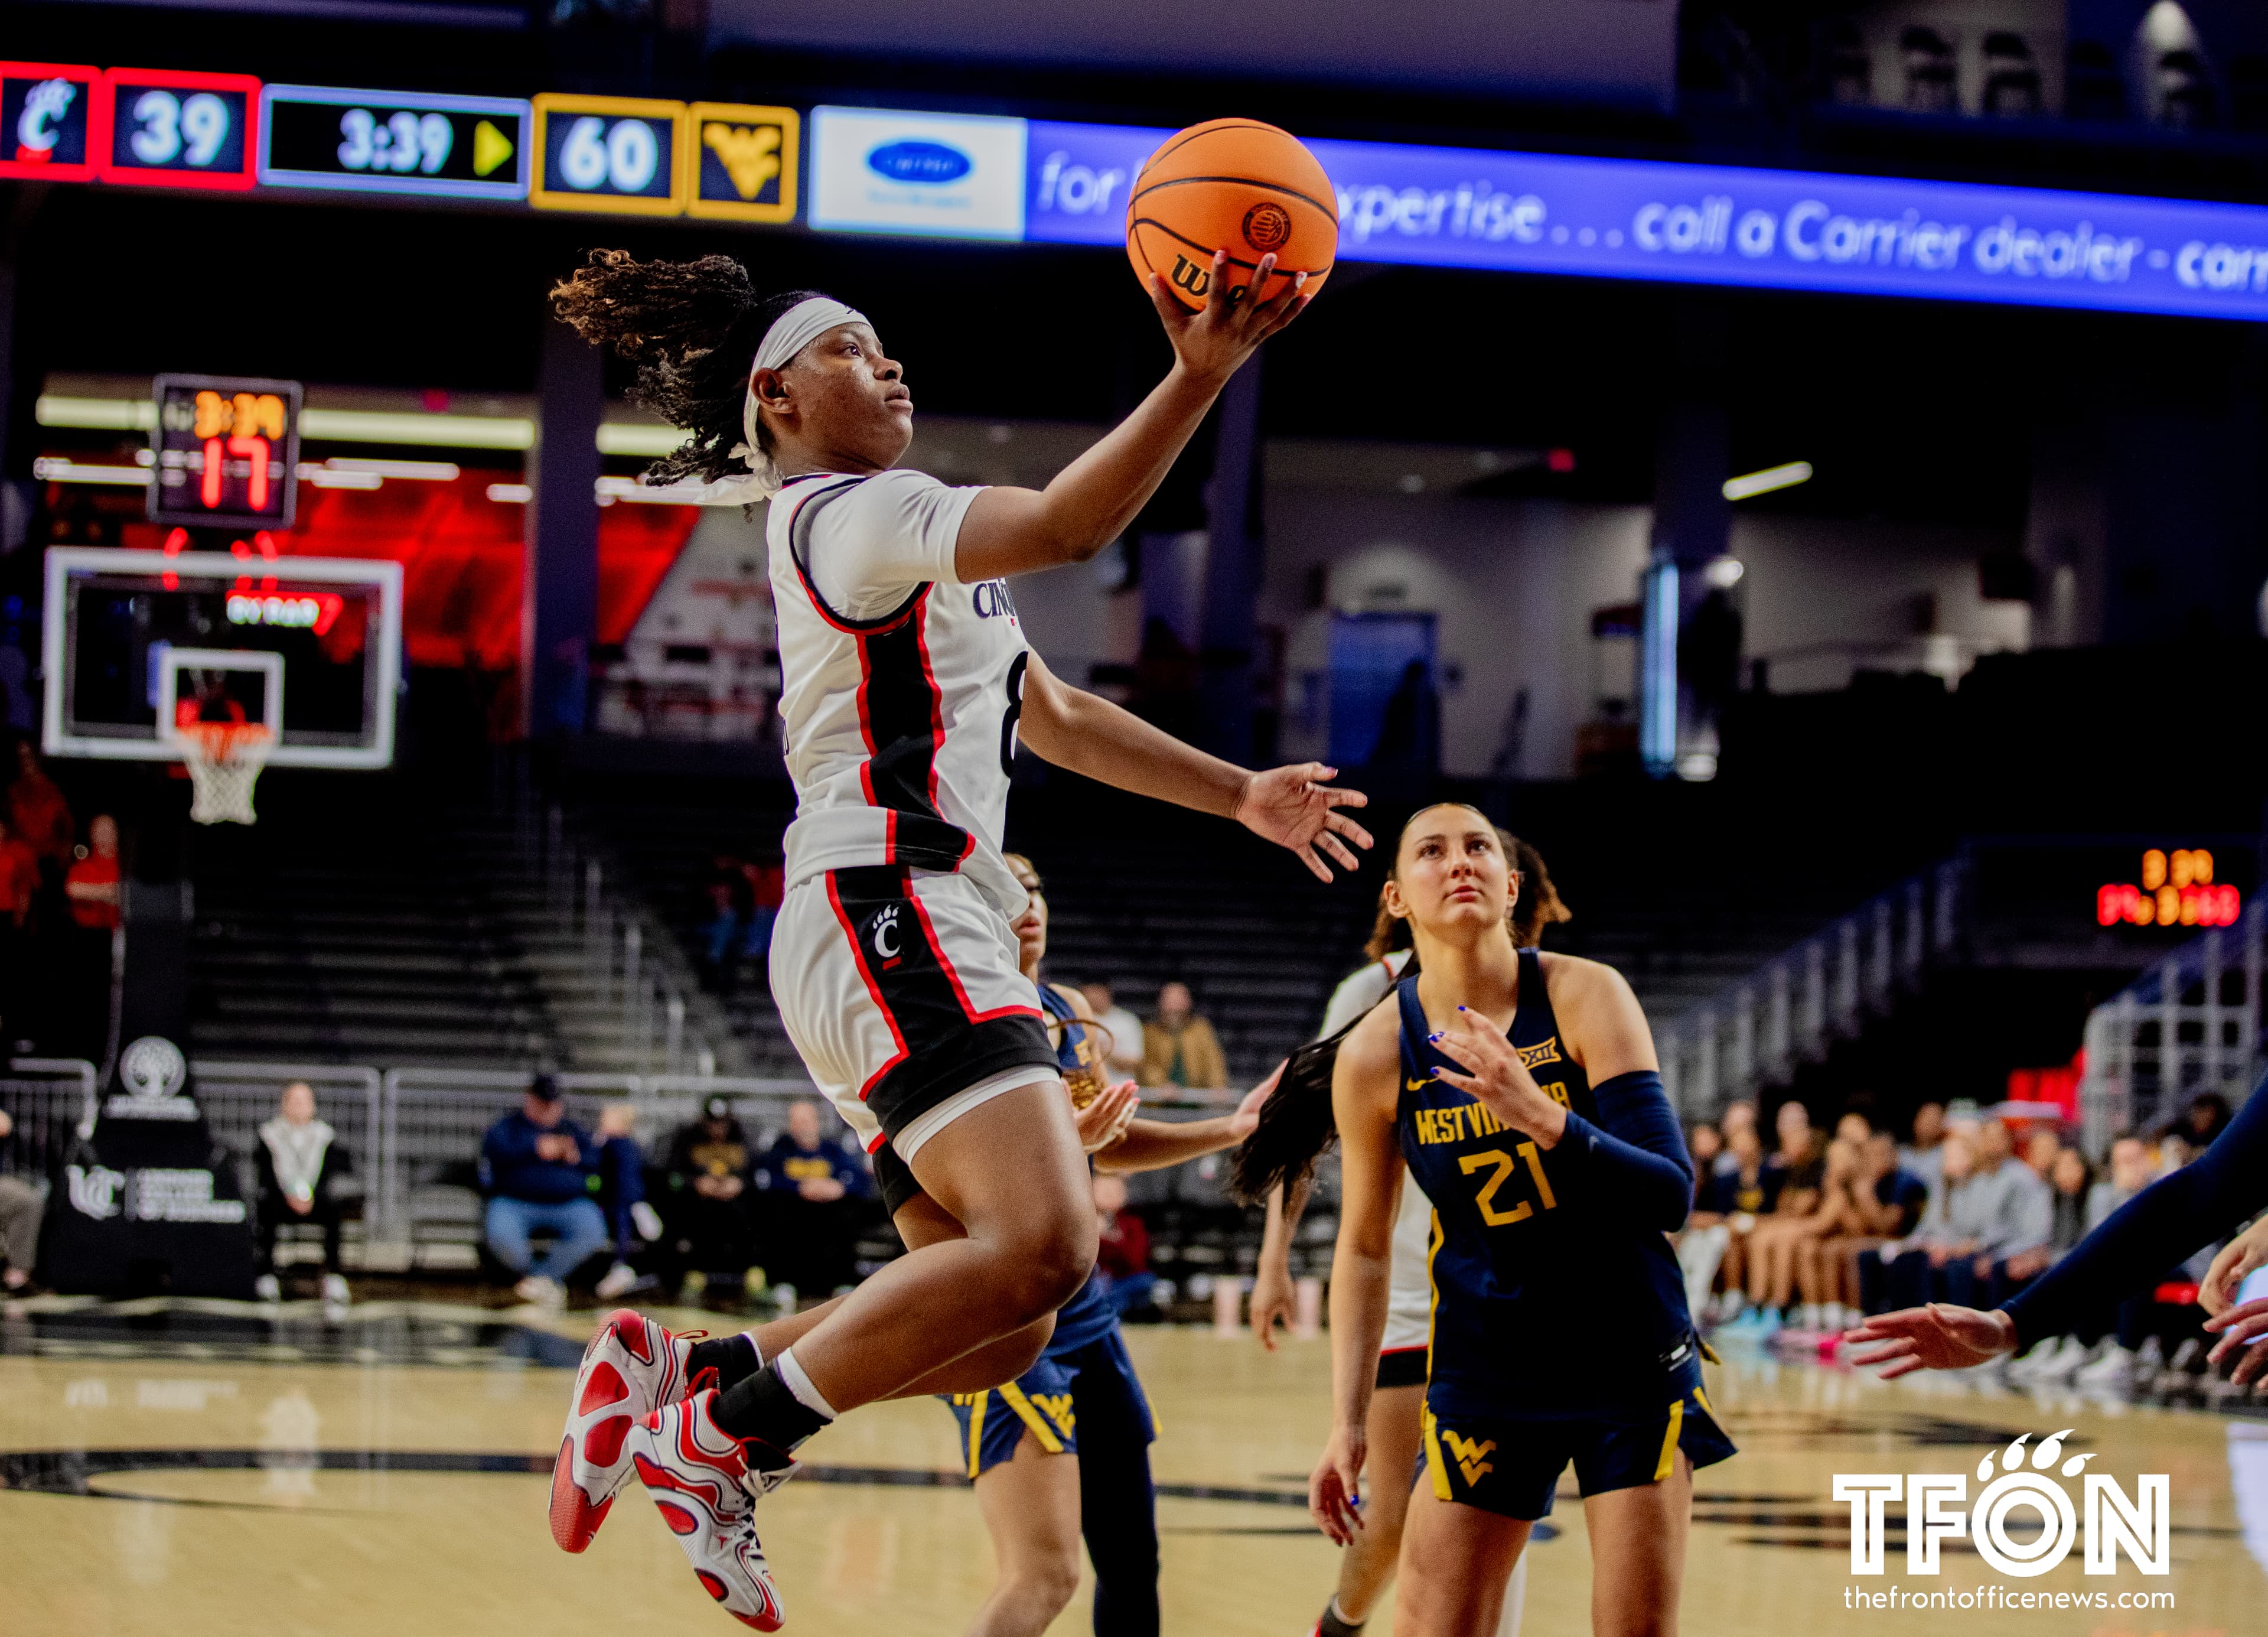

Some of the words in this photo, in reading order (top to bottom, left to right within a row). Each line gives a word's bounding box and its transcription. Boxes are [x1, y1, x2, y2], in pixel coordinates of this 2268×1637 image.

[131, 90, 230, 167] 39
[337, 108, 454, 174] 3:39
[559, 116, 659, 193] 60
[1035, 151, 1126, 214] for
[1634, 194, 1734, 254] call
[1735, 209, 1778, 258] a
[1783, 199, 1972, 271] Carrier
[1973, 214, 2145, 283] dealer
[201, 436, 270, 512] 17
[1416, 1107, 1465, 1145] WEST
[1458, 1141, 1557, 1227] 21
